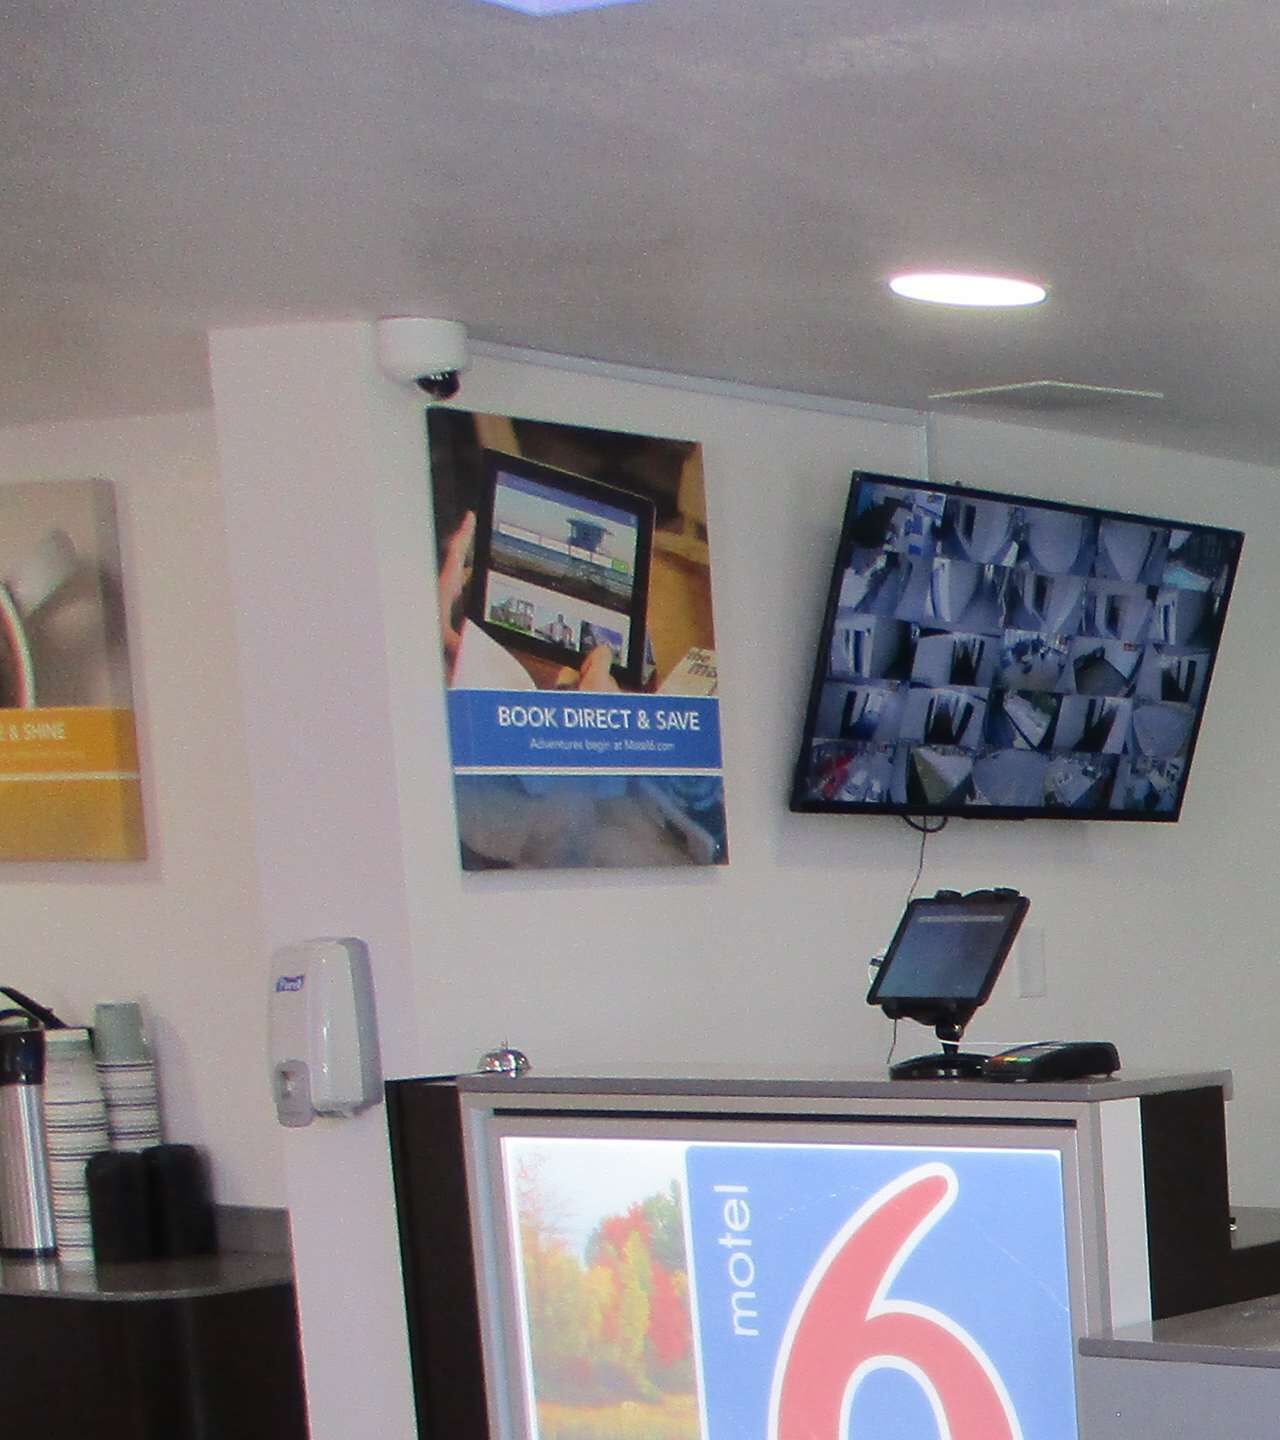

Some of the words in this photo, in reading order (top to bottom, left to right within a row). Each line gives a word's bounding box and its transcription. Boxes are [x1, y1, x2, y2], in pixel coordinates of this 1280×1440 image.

[498, 706, 560, 728] BOOK
[563, 708, 632, 730] DIRECT
[637, 710, 650, 731] &
[655, 710, 701, 731] SAVE
[714, 1184, 758, 1337] motel
